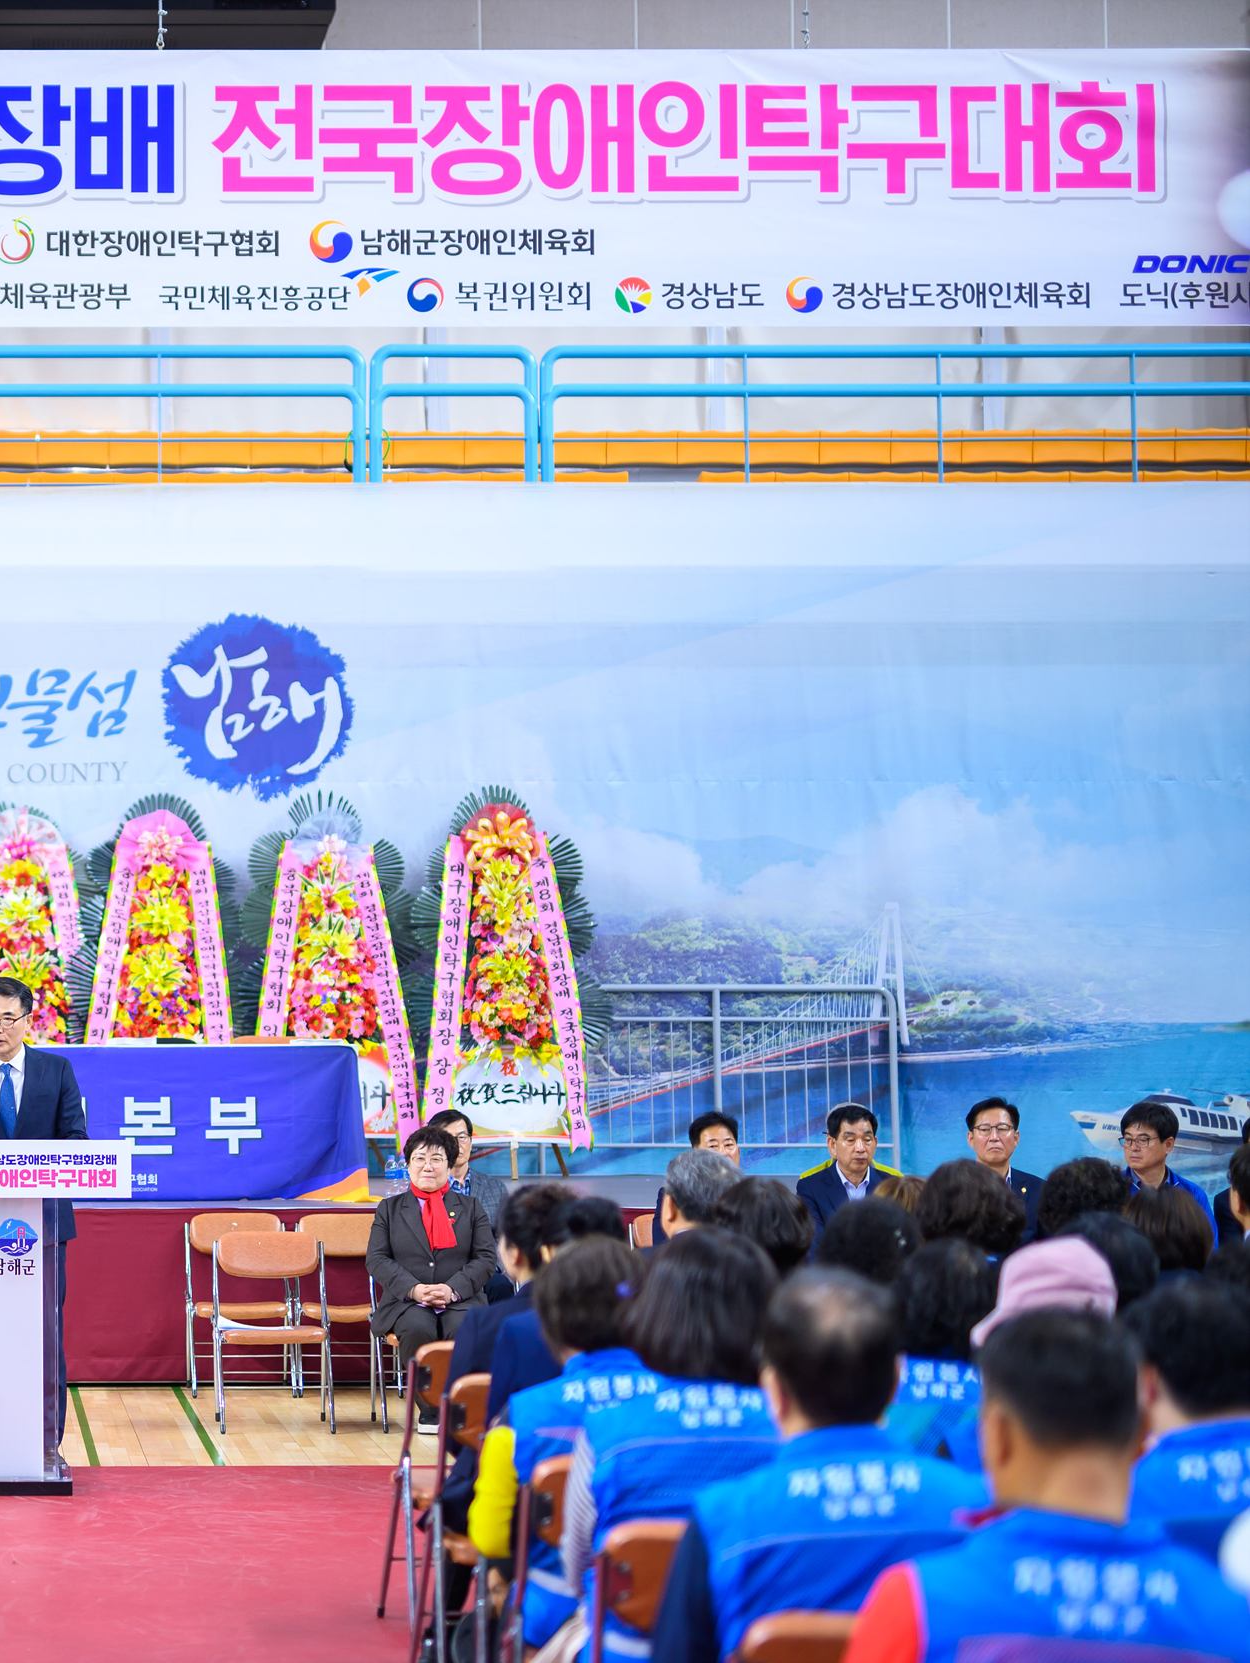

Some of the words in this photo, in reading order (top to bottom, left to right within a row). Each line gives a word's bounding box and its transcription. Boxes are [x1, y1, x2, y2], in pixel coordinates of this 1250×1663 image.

[211, 80, 1156, 196] 전국장애인탁구대회
[46, 229, 281, 258] 대한장애인탁구협회
[360, 228, 597, 257] 남해군장애인체육회
[1132, 255, 1250, 273] DONIC
[158, 285, 352, 312] 국민체육진흥공단
[455, 281, 592, 311] 복권위원회
[661, 282, 765, 311] 경상남도
[832, 282, 1092, 310] 경상남도장애인체육회
[6, 760, 129, 786] COUNTY
